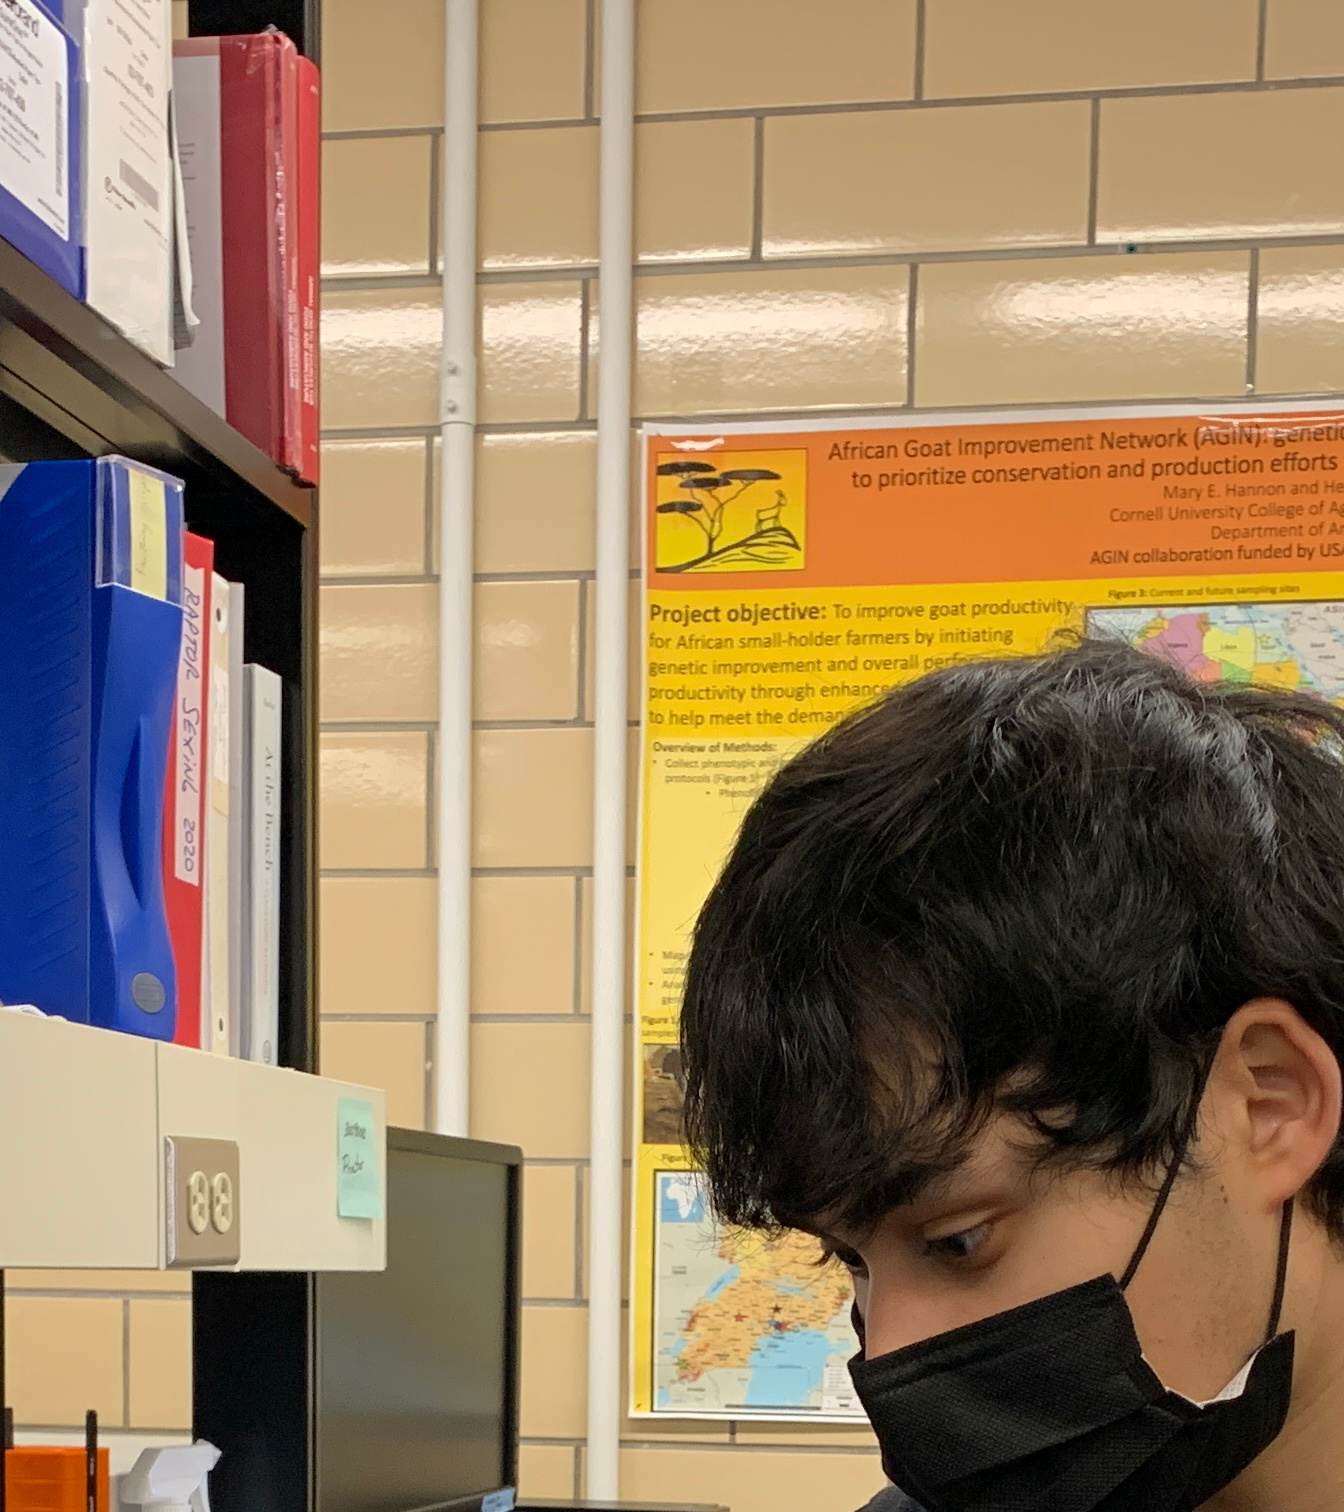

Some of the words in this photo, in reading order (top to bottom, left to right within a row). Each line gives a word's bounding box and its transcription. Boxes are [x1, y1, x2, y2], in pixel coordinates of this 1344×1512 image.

[828, 440, 898, 461] African
[901, 439, 951, 458] Goat
[955, 433, 1096, 463] Improvement
[1099, 427, 1189, 450] Network
[851, 470, 871, 488] to
[875, 466, 966, 492] prioritize
[970, 457, 1103, 484] conservation
[1106, 458, 1146, 479] and
[1150, 449, 1265, 481] production
[1269, 451, 1339, 473] efforts
[1162, 485, 1203, 502] Mary
[1206, 483, 1221, 499] E.
[1224, 483, 1286, 498] Hannon
[1289, 479, 1320, 496] and
[1108, 506, 1163, 523] Cornell
[1166, 504, 1244, 527] University
[1246, 502, 1305, 520] College
[1307, 499, 1325, 516] of
[1210, 523, 1305, 545] Department
[1307, 520, 1325, 537] of
[1089, 549, 1129, 565] AGIN
[1131, 547, 1234, 564] collaboration
[1236, 543, 1293, 560] funded
[1295, 543, 1316, 561] by
[649, 603, 722, 628] Project
[726, 601, 827, 627] objective:
[833, 603, 852, 619] To
[855, 603, 925, 622] improve
[928, 602, 967, 621] goat
[969, 597, 1074, 621] productivity
[183, 586, 201, 680] RAPTOR
[649, 631, 672, 649] for
[675, 633, 735, 649] African
[737, 630, 842, 648] small-holder
[845, 629, 911, 646] farmers
[913, 627, 935, 648] by
[938, 626, 1014, 650] initiating
[649, 659, 708, 678] genetic
[711, 659, 823, 678] improvement
[826, 655, 859, 672] and
[861, 654, 919, 671] overall
[649, 684, 747, 704] productivity
[749, 682, 819, 702] through
[649, 710, 665, 725] to
[668, 709, 705, 729] help
[708, 709, 752, 724] meet
[755, 708, 785, 724] the
[183, 817, 198, 873] 2020
